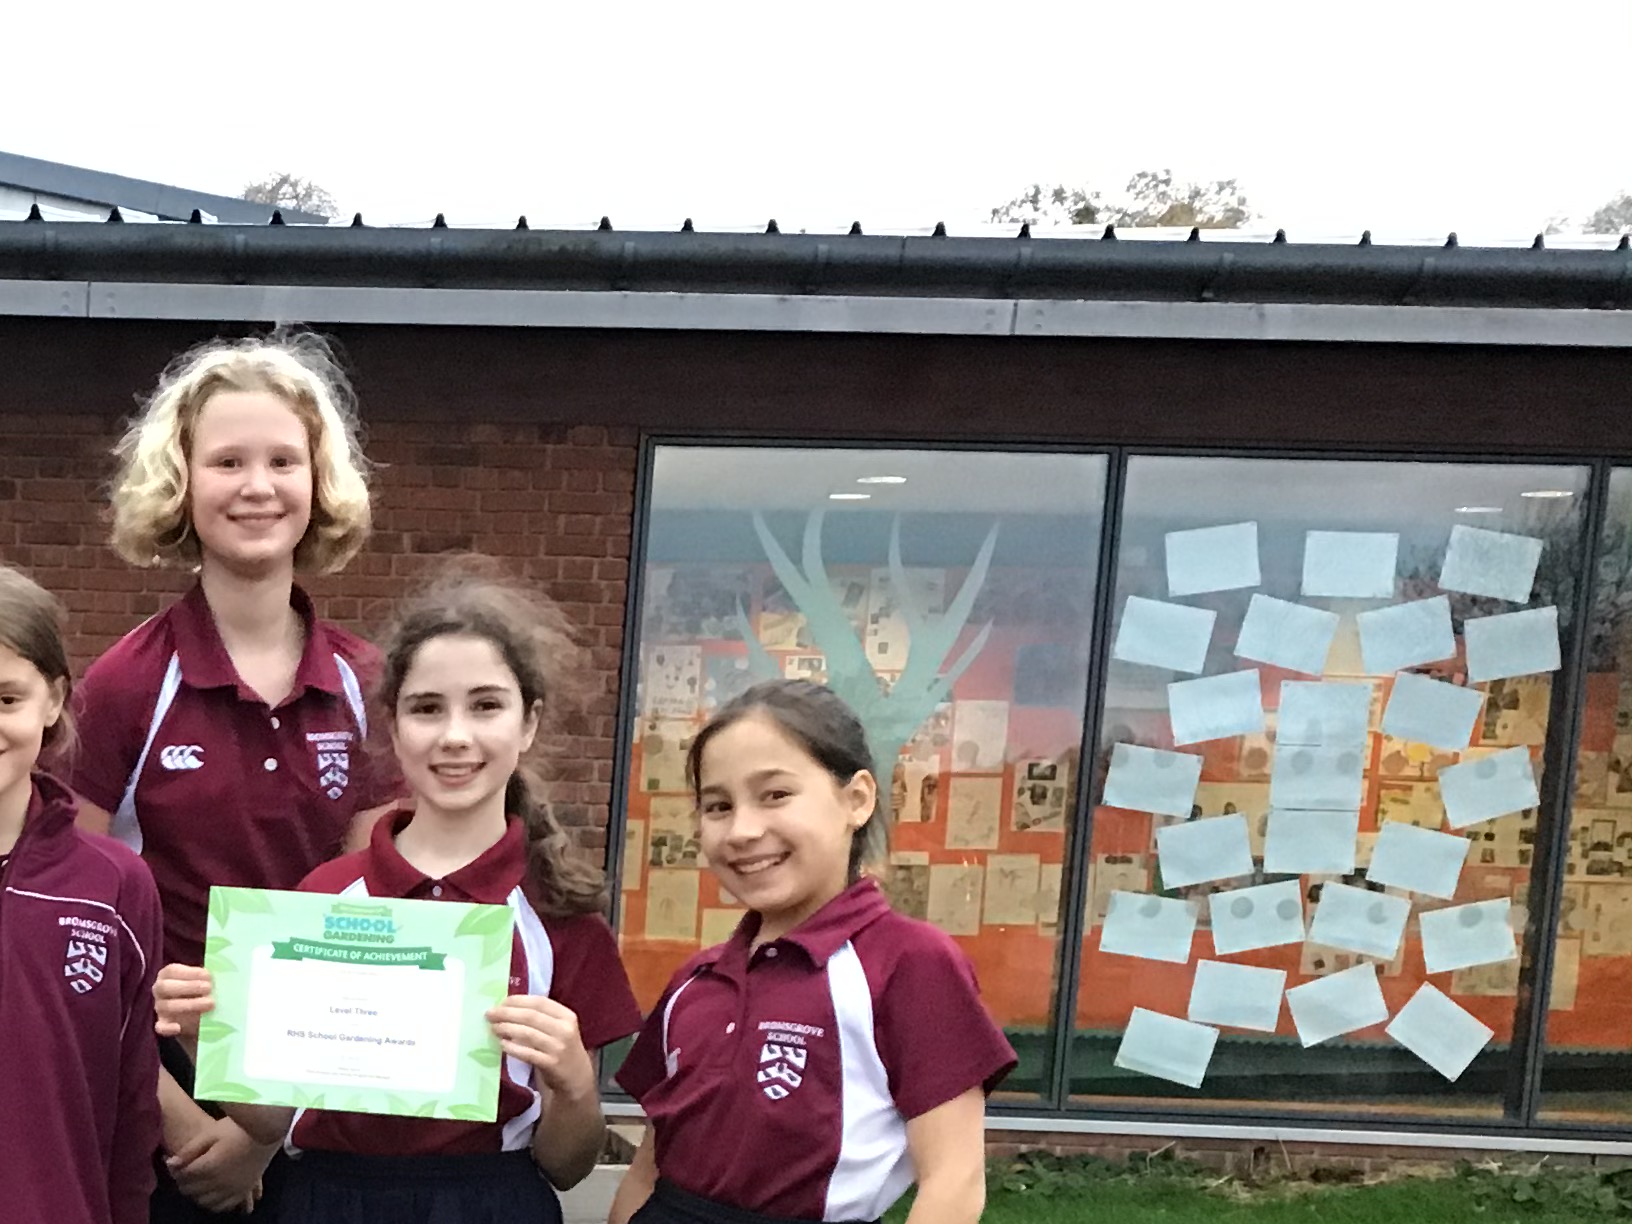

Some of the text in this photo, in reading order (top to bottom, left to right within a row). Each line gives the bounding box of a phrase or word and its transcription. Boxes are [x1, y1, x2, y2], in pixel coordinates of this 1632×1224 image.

[324, 916, 397, 933] SCHOOL
[71, 928, 106, 944] SCHOOL
[323, 930, 395, 944] GARDENING
[293, 942, 428, 962] CERTIFICATE OF ACHIEVEMENT
[329, 1005, 378, 1016] Level Three
[308, 1030, 337, 1040] School
[339, 1033, 382, 1046] Gardening
[384, 1036, 416, 1047] Awards
[767, 1031, 806, 1045] SCHOOL
